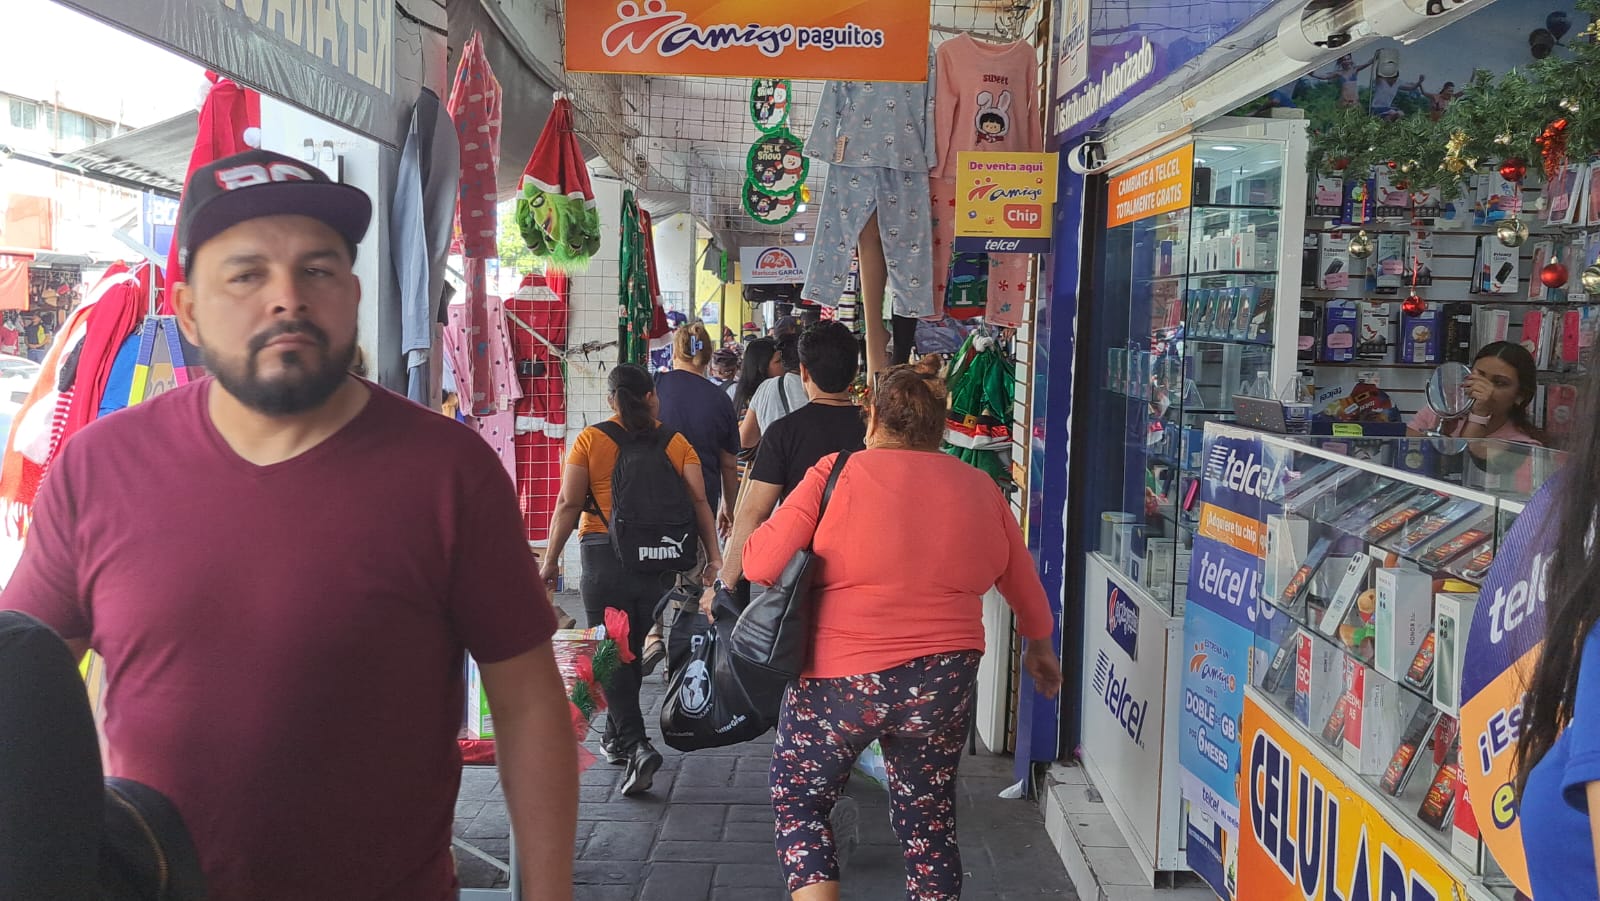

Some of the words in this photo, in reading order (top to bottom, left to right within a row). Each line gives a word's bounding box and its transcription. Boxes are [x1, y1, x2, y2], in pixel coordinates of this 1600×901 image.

[659, 24, 793, 55] amigo
[799, 25, 883, 49] paguitos
[1054, 81, 1101, 136] Distribuidor
[1100, 36, 1154, 108] Autorizado
[969, 161, 983, 170] De
[986, 162, 1017, 171] venta
[1118, 168, 1148, 197] CAMBIATE
[1148, 168, 1154, 185] A
[1155, 157, 1181, 182] TELCEL
[989, 186, 1042, 201] amigo
[1116, 191, 1156, 219] TOTALMENTE
[1156, 182, 1182, 208] GRATIS
[1007, 209, 1038, 224] Chip
[984, 239, 1020, 251] telcel
[1222, 449, 1282, 501] telcel
[1235, 521, 1242, 537] tu
[1242, 524, 1257, 545] chip
[639, 546, 682, 561] PUMA
[1198, 551, 1250, 607] telcel
[1104, 663, 1148, 745] telcel
[1185, 689, 1216, 727] DOBLE
[1221, 713, 1236, 741] GB
[1202, 786, 1219, 813] telcel
